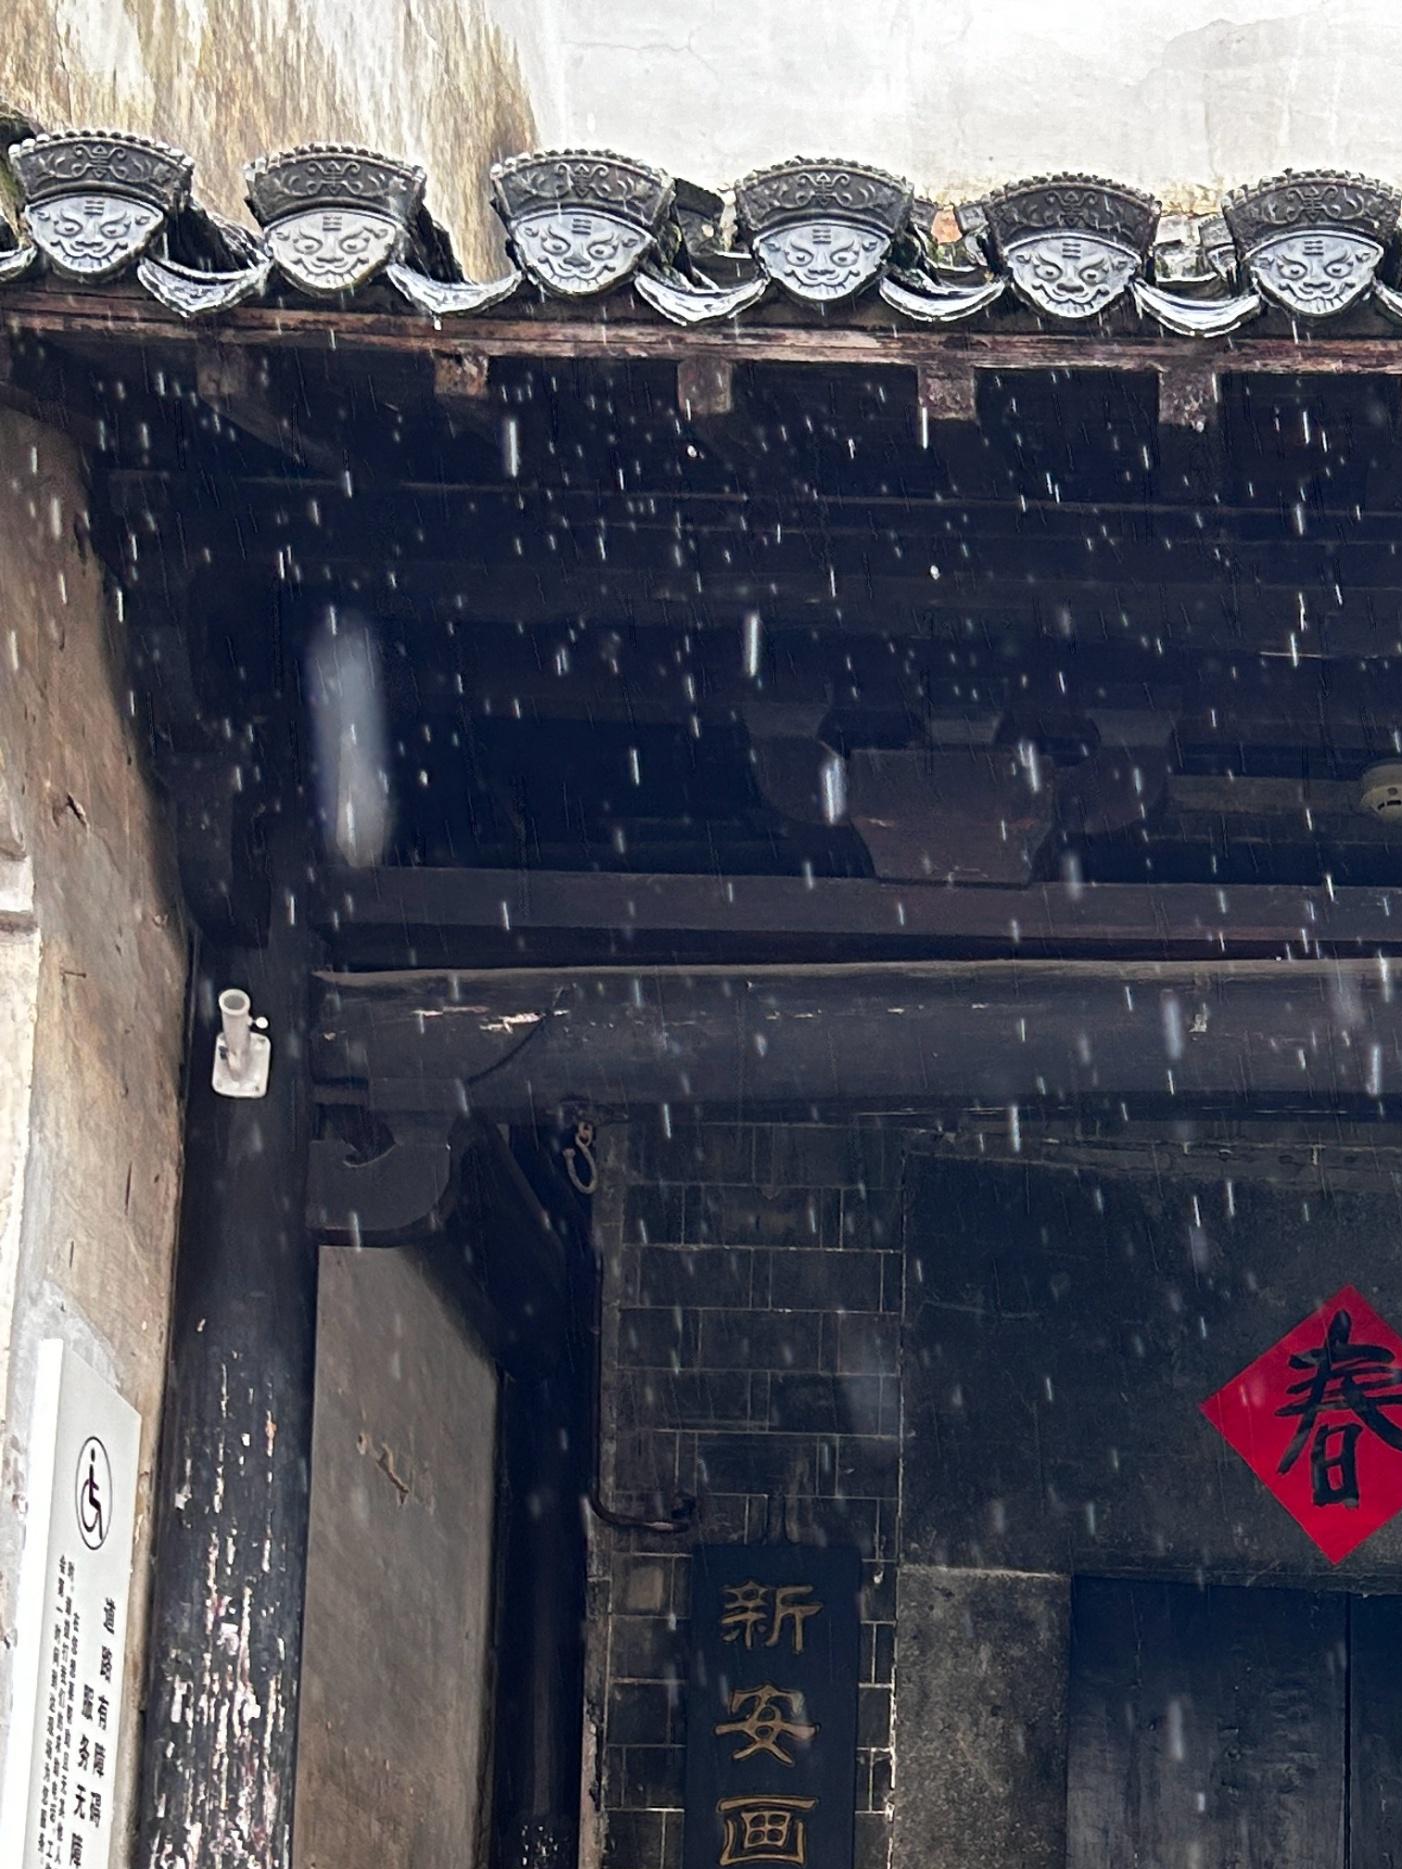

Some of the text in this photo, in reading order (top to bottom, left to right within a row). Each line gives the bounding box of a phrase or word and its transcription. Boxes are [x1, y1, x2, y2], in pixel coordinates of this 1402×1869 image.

[89, 1597, 116, 1828] 道路有障碍
